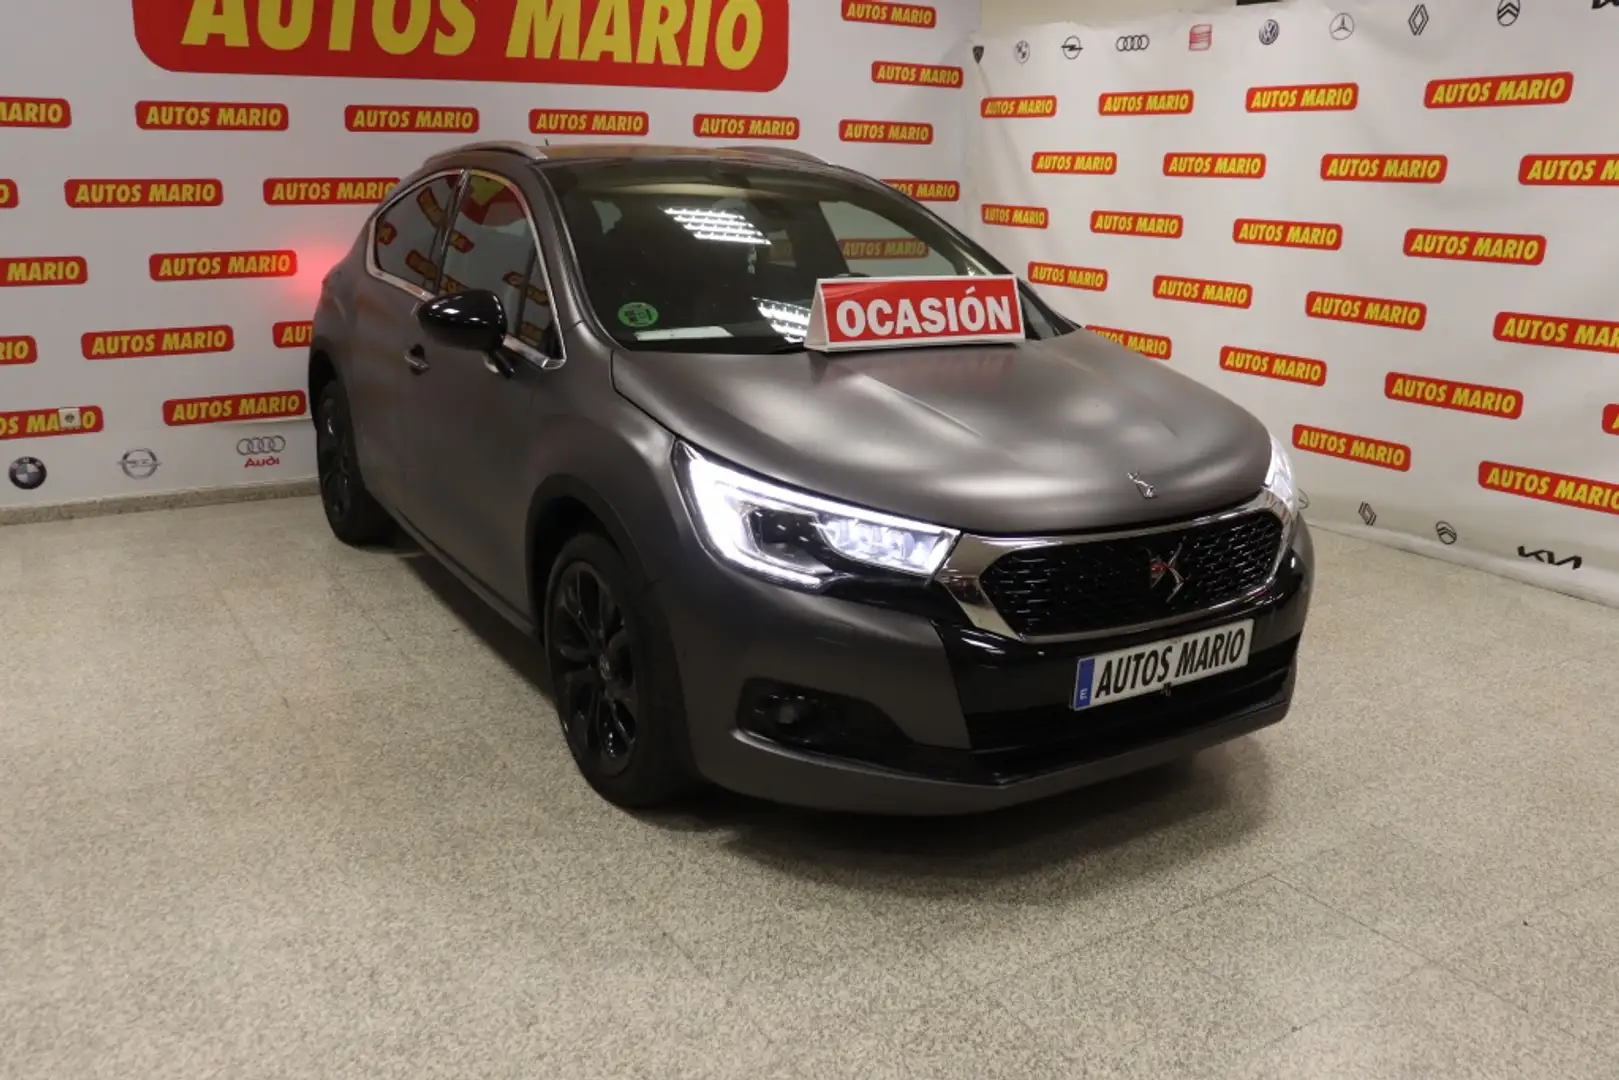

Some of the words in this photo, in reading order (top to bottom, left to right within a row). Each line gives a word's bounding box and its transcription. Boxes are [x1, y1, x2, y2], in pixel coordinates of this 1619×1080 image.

[847, 2, 888, 20] AUTOS
[890, 7, 933, 24] MARIO
[180, 0, 476, 56] AUTOS
[505, 0, 764, 71] MARIO
[877, 65, 917, 81] AUTOS
[919, 68, 960, 84] MARIO
[1251, 89, 1298, 109] AUTOS
[1300, 87, 1354, 107] MARIO
[1431, 81, 1492, 104] AUTOS
[1495, 77, 1566, 101] MARIO
[984, 100, 1016, 115] AUTOS
[1016, 99, 1054, 115] MARIO
[1103, 95, 1143, 113] AUTOS
[1145, 94, 1190, 112] MARIO
[145, 105, 210, 126] AUTOS
[216, 107, 282, 126] MARIO
[353, 110, 410, 128] AUTOS
[415, 111, 474, 129] MARIO
[537, 113, 587, 131] AUTOS
[591, 114, 644, 132] MARIO
[701, 117, 745, 134] AUTOS
[748, 119, 795, 135] MARIO
[845, 123, 886, 139] AUTOS
[887, 125, 930, 141] MARIO
[1036, 154, 1073, 170] AUTOS
[1073, 155, 1114, 171] MARIO
[1168, 156, 1213, 174] AUTOS
[1213, 157, 1262, 175] MARIO
[1327, 157, 1380, 177] AUTOS
[1382, 159, 1442, 179] MARIO
[1526, 159, 1597, 182] AUTOS
[75, 183, 142, 203] AUTOS
[148, 183, 216, 202] MARIO
[274, 182, 331, 201] AUTOS
[915, 183, 956, 198] MARIO
[984, 207, 1011, 223] AUTOS
[1011, 208, 1046, 225] MARIO
[1095, 214, 1134, 232] AUTOS
[1135, 215, 1179, 235] MARIO
[1238, 223, 1284, 242] AUTOS
[1286, 225, 1338, 246] MARIO
[842, 241, 882, 257] AUTOS
[883, 240, 926, 258] MARIO
[1410, 233, 1470, 255] AUTOS
[1472, 237, 1539, 261] MARIO
[6, 261, 81, 281] MARIO
[160, 257, 221, 276] AUTOS
[227, 254, 291, 275] MARIO
[1032, 265, 1066, 283] AUTOS
[1067, 269, 1105, 288] MARIO
[1157, 279, 1200, 299] AUTOS
[1202, 284, 1248, 305] MARIO
[835, 285, 1013, 338] OCASIÓN
[1311, 295, 1363, 318] AUTOS
[1363, 302, 1421, 326] MARIO
[1501, 317, 1569, 343] AUTOS
[91, 334, 155, 354] AUTOS
[161, 330, 227, 351] MARIO
[1127, 335, 1168, 356] MARIO
[1225, 351, 1269, 372] AUTOS
[1271, 358, 1322, 382] MARIO
[1392, 378, 1448, 403] AUTOS
[1451, 386, 1517, 414] MARIO
[173, 399, 233, 422] AUTOS
[238, 394, 300, 415] MARIO
[26, 410, 97, 434] MAO
[1298, 429, 1347, 454] AUTOS
[1350, 439, 1406, 466] MARIO
[243, 455, 281, 469] Audi
[1486, 467, 1551, 495] AUTOS
[1094, 645, 1173, 699] AUTOS
[1174, 627, 1246, 678] MARIO
